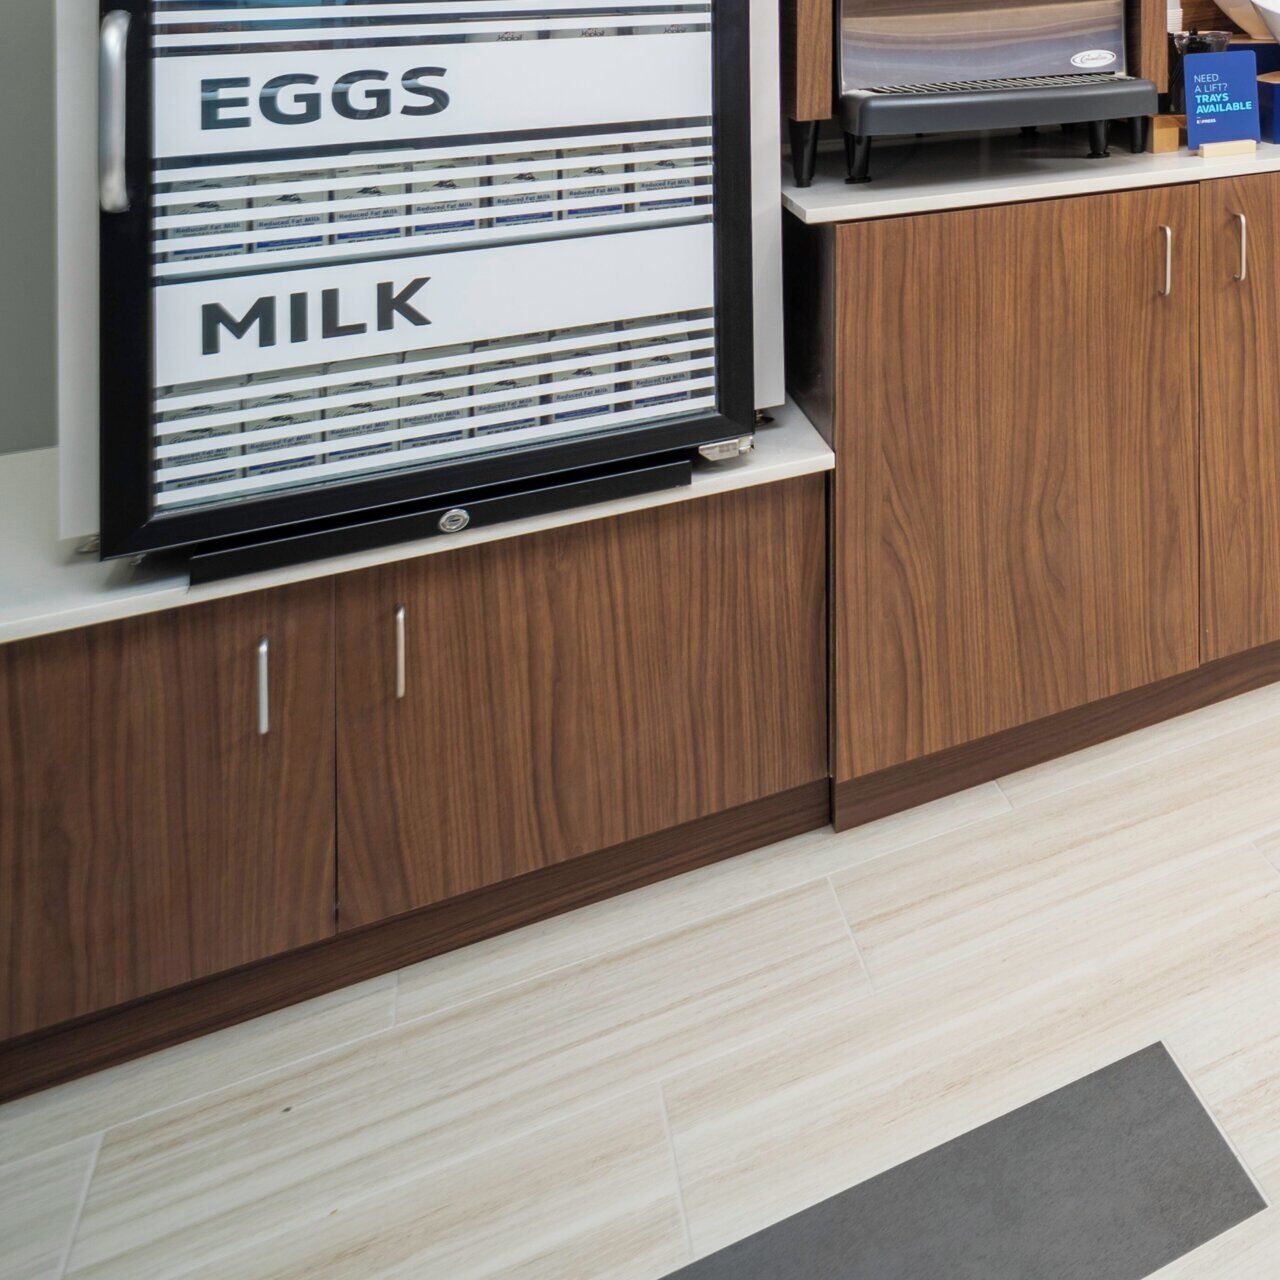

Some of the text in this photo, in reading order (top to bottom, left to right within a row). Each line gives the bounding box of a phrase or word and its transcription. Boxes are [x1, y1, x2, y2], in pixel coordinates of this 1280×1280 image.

[1194, 73, 1219, 83] NEED
[1194, 83, 1228, 93] A LIFT?
[200, 65, 451, 132] EGGS
[1195, 93, 1229, 103] TRAYS
[1196, 101, 1252, 114] AVAILABLE
[200, 276, 432, 356] MILK
